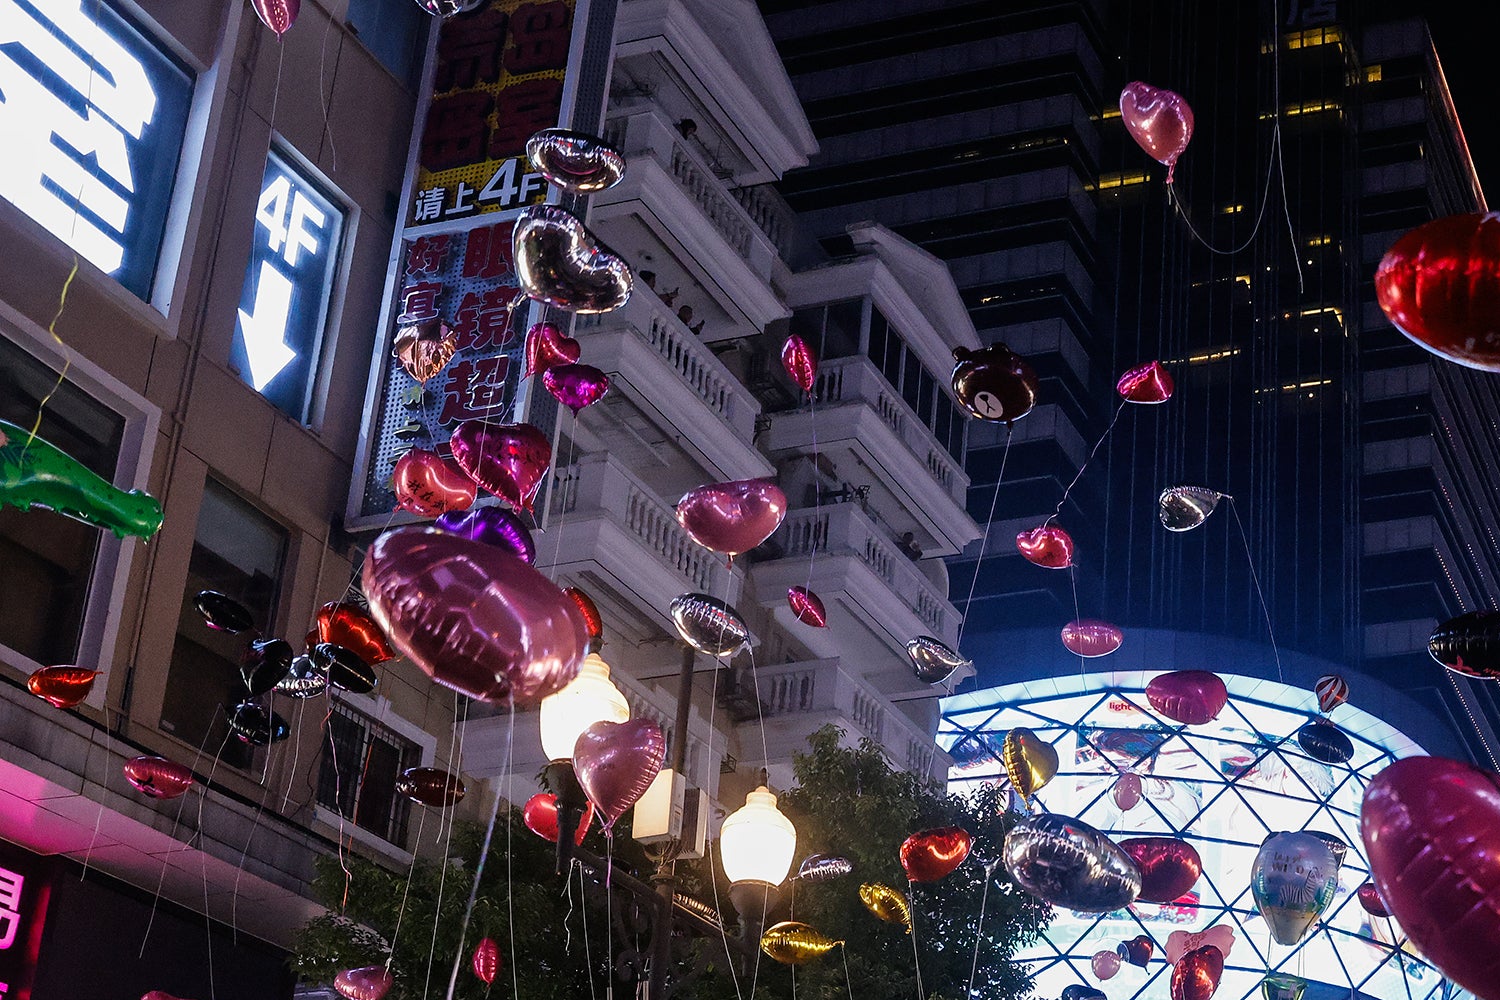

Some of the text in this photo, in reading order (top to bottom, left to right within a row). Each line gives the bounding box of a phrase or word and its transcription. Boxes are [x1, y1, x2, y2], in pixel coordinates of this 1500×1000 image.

[256, 175, 326, 268] 4F
[436, 221, 520, 460] 眼镜超
